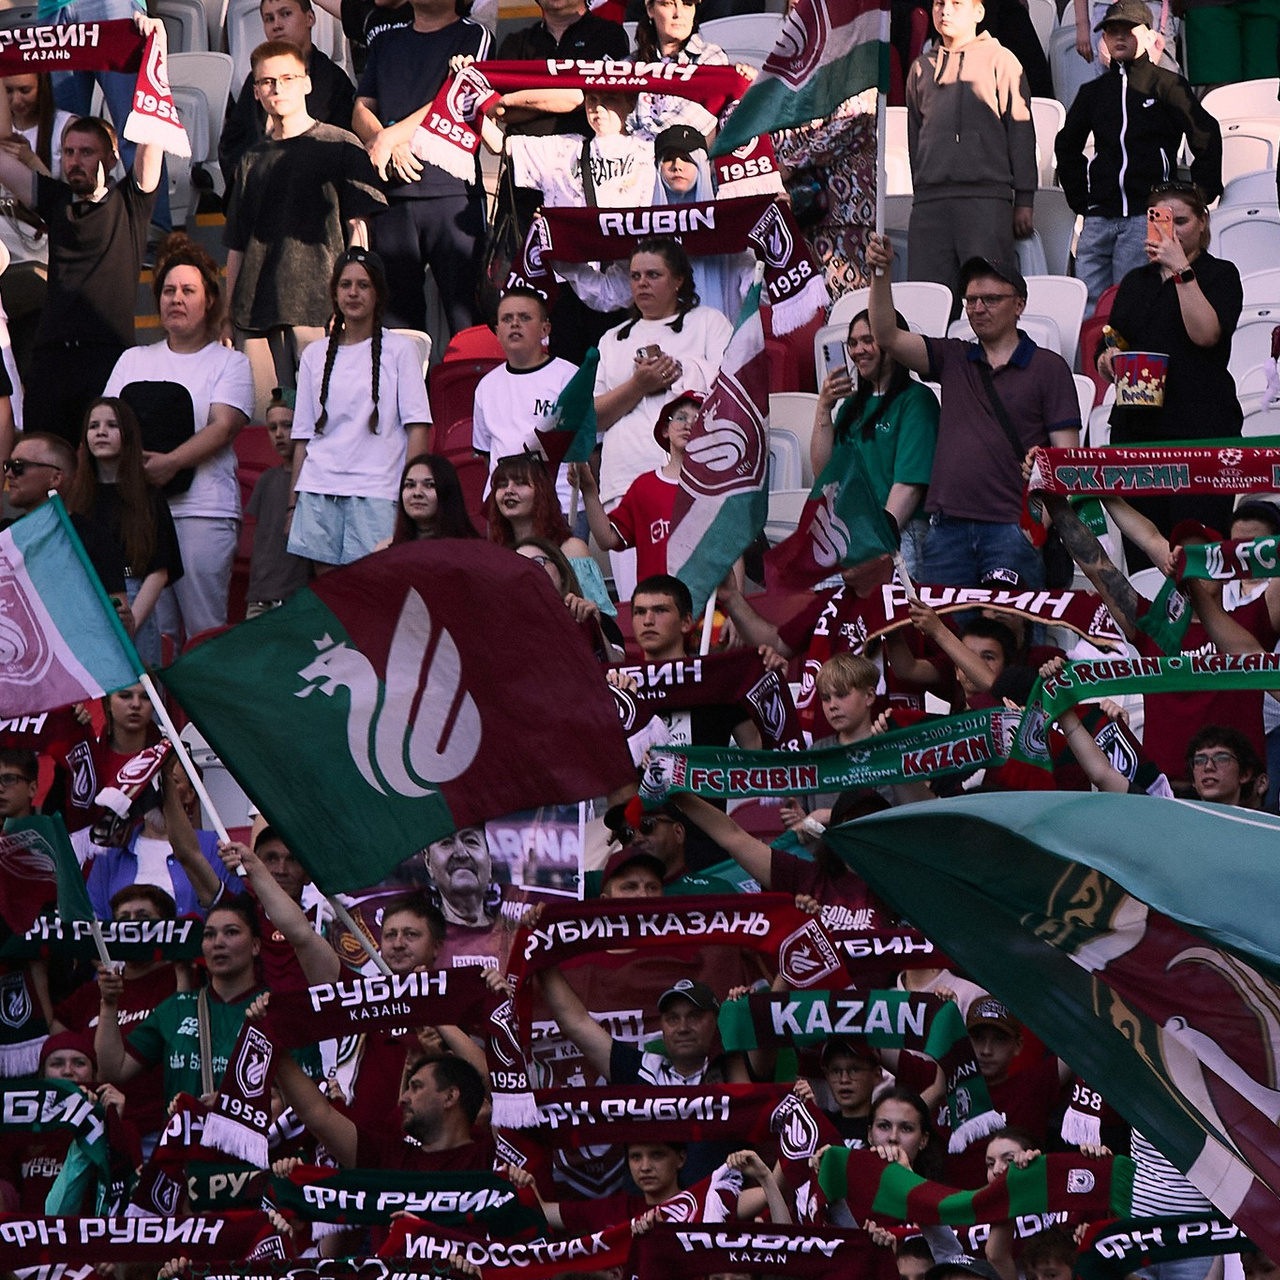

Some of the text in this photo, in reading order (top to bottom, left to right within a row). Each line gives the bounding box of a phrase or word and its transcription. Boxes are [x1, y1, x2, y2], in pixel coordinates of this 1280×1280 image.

[0, 22, 100, 53] РУБИН
[22, 50, 71, 62] КАЗАНЬ
[585, 75, 649, 85] КАЗАНЬ
[135, 90, 179, 123] 1958
[428, 112, 477, 149] 1958
[719, 155, 774, 181] 1958
[599, 205, 716, 237] RUBIN
[769, 259, 813, 299] 1958
[1063, 448, 1107, 460] Лига
[1116, 448, 1213, 459] Чемпионов
[1055, 464, 1099, 491] ФК
[1100, 462, 1191, 492] РУБИН
[1194, 475, 1270, 484] CHAMPIONS
[1235, 537, 1277, 571] FC
[612, 658, 703, 687] БИН
[1042, 671, 1073, 698] FC
[1074, 656, 1163, 684] RUBIN
[637, 690, 667, 701] АНЬ
[691, 733, 993, 793] FC RUBIN KAZAN
[73, 919, 194, 944] РУБИН
[523, 911, 771, 961] РУБИН КАЗАНЬ
[836, 935, 935, 959] БИН
[308, 970, 448, 1013] РУБИН
[349, 1002, 412, 1022] КАЗАНЬ
[769, 999, 927, 1037] KAZAN
[490, 1070, 528, 1090] 1958
[220, 1093, 270, 1129] 1958
[600, 1095, 731, 1122] РУБИН
[1073, 1083, 1103, 1110] 958
[3, 1089, 105, 1145] БИН
[303, 1184, 515, 1213] ФК РУБИН
[0, 1216, 226, 1248] ФК РУБИН
[1095, 1226, 1166, 1260] ФК
[404, 1229, 611, 1268] ИНГОССТРАХ
[729, 1250, 787, 1264] KAZAN
